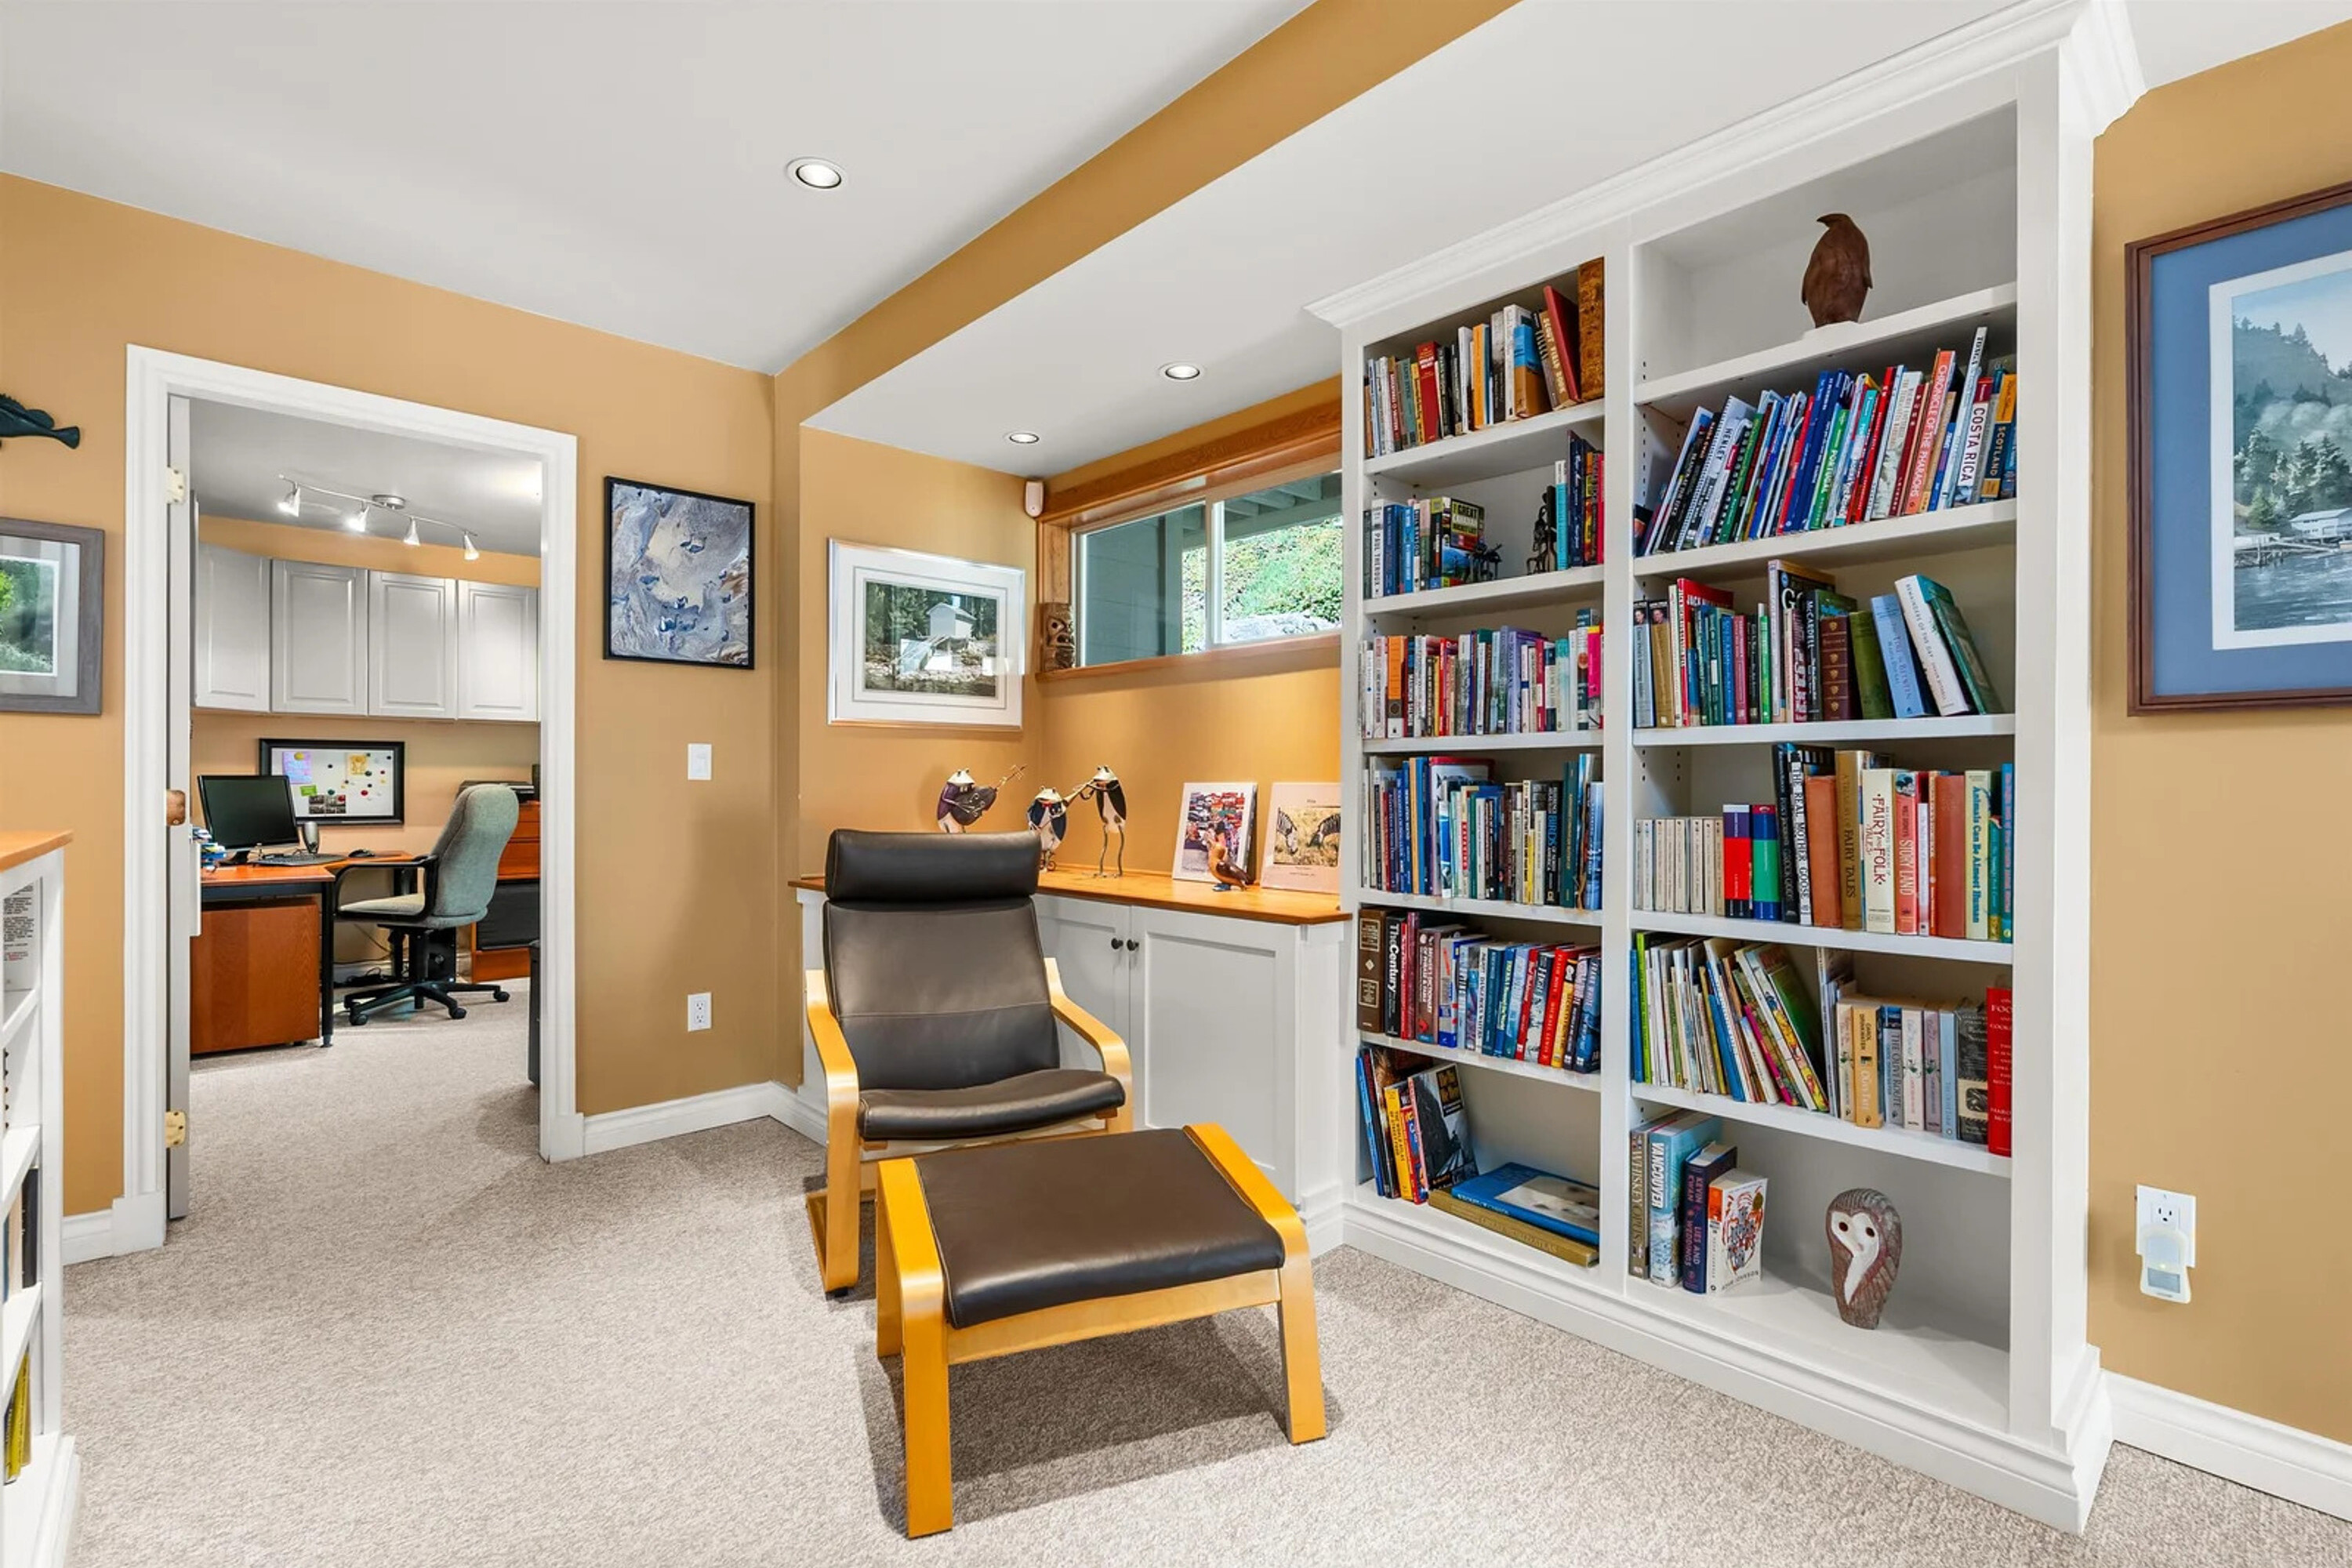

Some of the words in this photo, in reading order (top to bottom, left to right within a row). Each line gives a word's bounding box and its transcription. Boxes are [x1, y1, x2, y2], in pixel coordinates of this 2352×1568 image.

[1929, 365, 1947, 418] CHRONICLE
[1924, 432, 1934, 448] THE
[1966, 407, 1985, 448] COSTA
[1716, 428, 1733, 461] HENLEY
[1989, 426, 2006, 476] SCOTLAND
[1911, 452, 1929, 498] PHARAOHS
[1960, 453, 1977, 481] RICA
[1806, 600, 1815, 648] McCARDELL
[1792, 767, 1801, 785] THE
[1794, 792, 1802, 818] REAL
[1872, 797, 1885, 837] FAIRY
[1973, 786, 1982, 823] Animals
[1548, 815, 1557, 847] BIRDS
[1796, 825, 1806, 861] MOTHER
[1844, 829, 1853, 862] FAIRY
[1973, 825, 1981, 842] Can
[1874, 848, 1887, 883] FOLK
[1899, 840, 1913, 867] STORY
[1973, 844, 1981, 855] Be
[1798, 867, 1808, 898] GOOSE
[1846, 866, 1856, 898] TALES
[1899, 869, 1914, 895] LAND
[1973, 856, 1981, 889] Almost
[1973, 890, 1981, 923] Human
[1892, 1053, 1900, 1076] OLIVE
[1893, 1080, 1901, 1108] ROUTE
[1632, 1150, 1642, 1206] WHISKEY
[1651, 1142, 1664, 1208] VANCOUVER
[1695, 1176, 1704, 1204] KEVIN
[1632, 1203, 1642, 1241] OPUS
